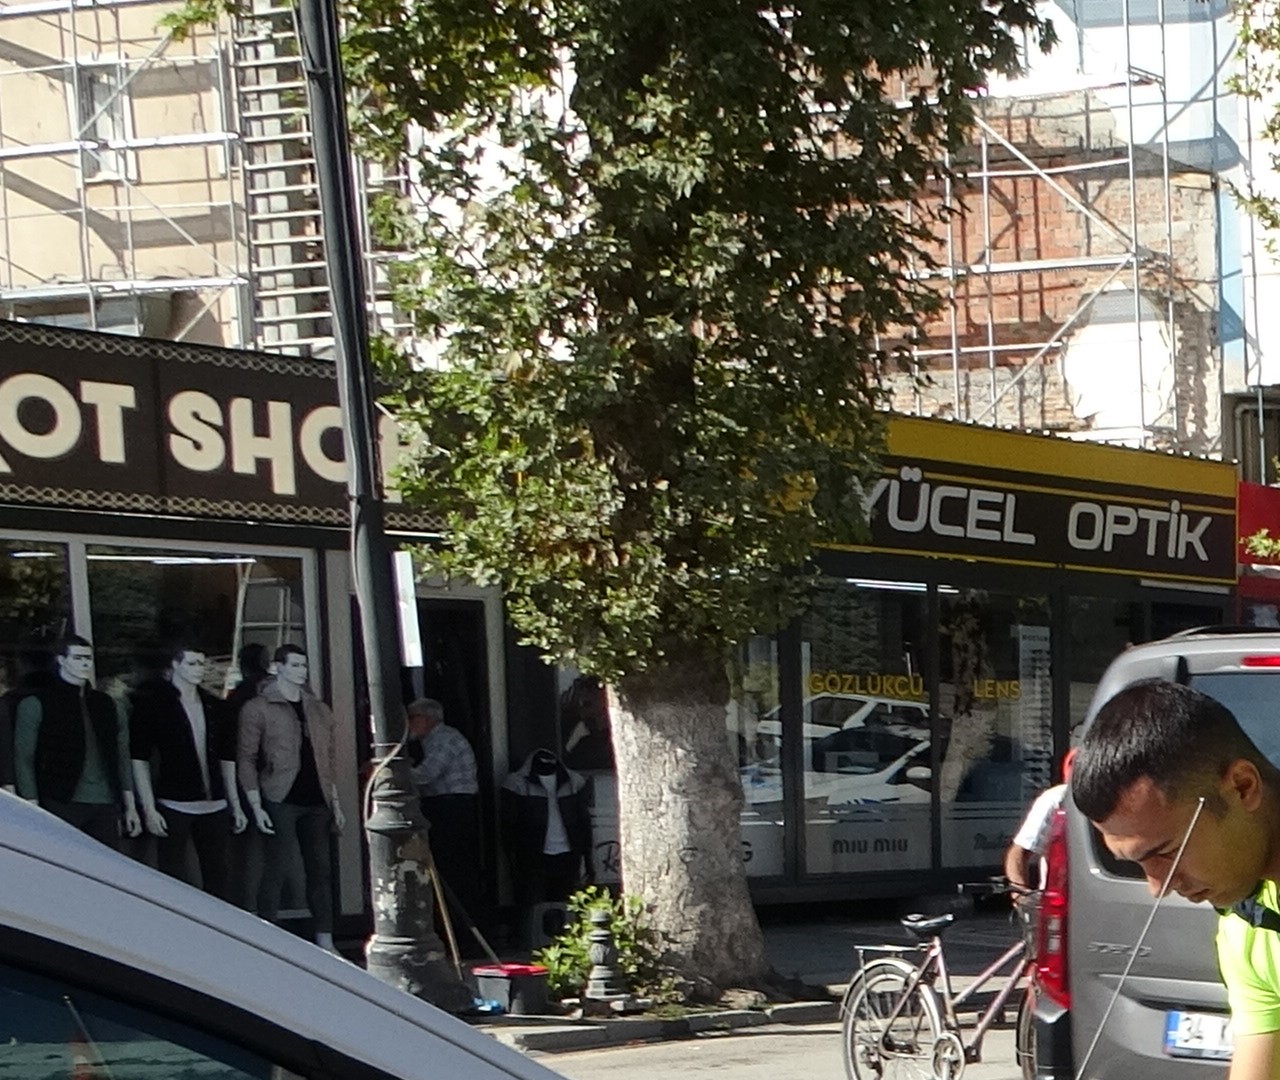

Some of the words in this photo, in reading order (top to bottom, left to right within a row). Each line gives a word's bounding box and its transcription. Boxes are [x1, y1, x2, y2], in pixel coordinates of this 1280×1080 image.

[0, 372, 136, 474] OT
[852, 465, 1036, 545] YÜCEL
[1067, 499, 1213, 562] OPTİK
[973, 679, 1022, 698] LENS
